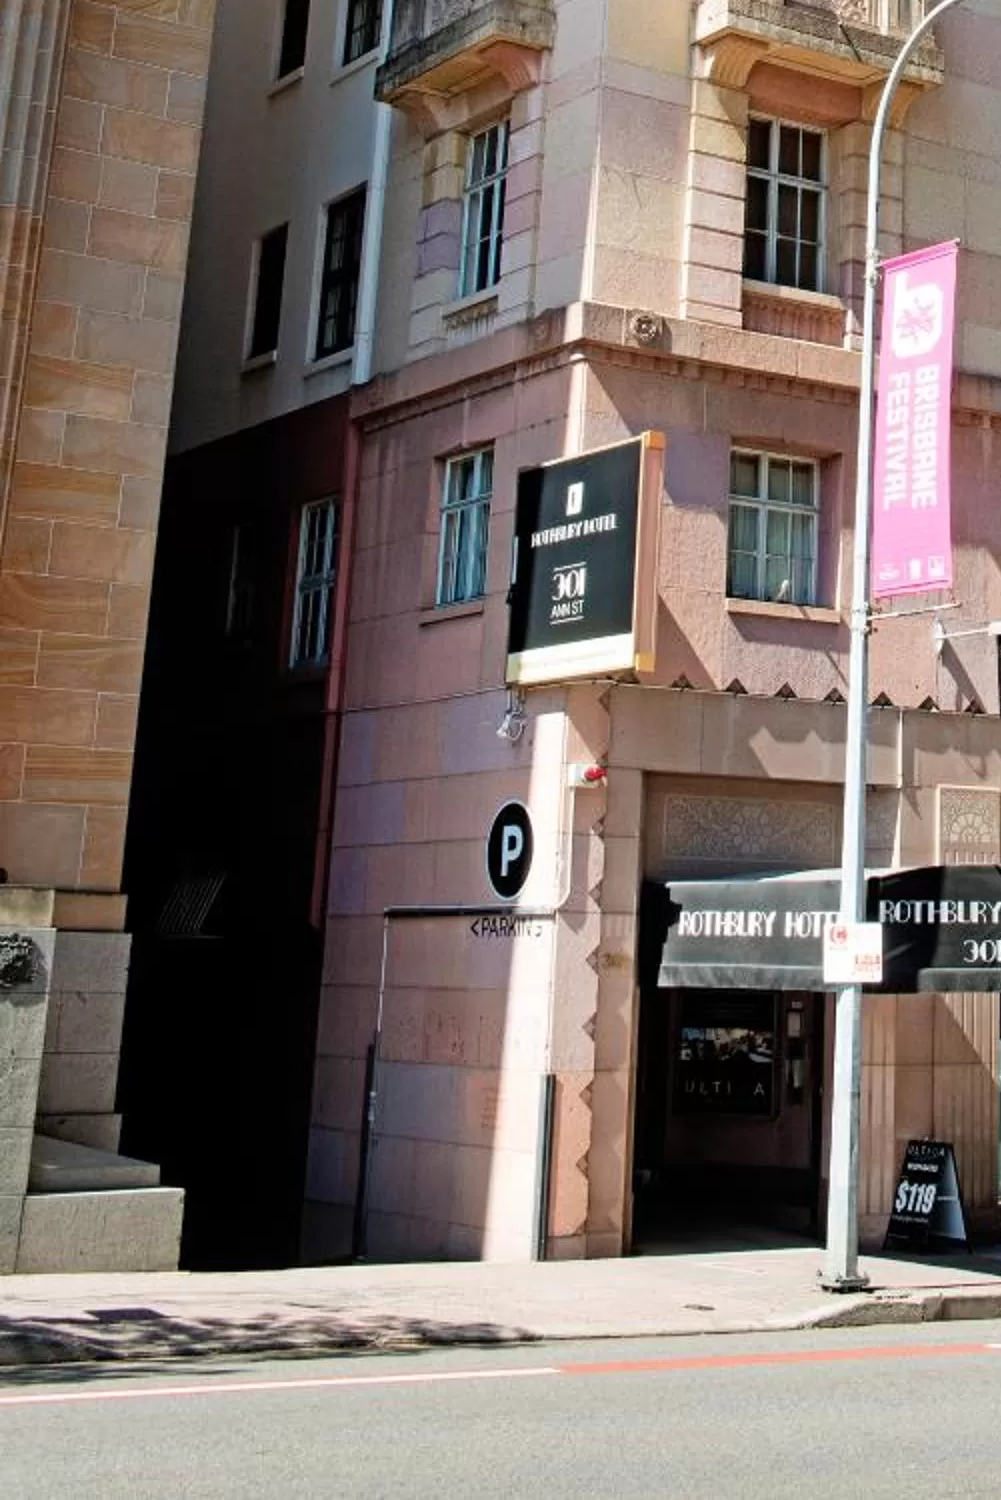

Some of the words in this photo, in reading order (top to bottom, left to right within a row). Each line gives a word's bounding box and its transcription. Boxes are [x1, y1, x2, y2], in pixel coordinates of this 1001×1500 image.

[883, 371, 910, 511] FESTIVAL
[911, 364, 939, 509] BRISBANE
[553, 568, 587, 600] 301
[551, 602, 571, 619] ANN
[571, 599, 585, 614] ST
[501, 824, 524, 877] P
[677, 911, 776, 937] ROTHBURY
[784, 911, 842, 938] HOT
[684, 1078, 766, 1096] ULTIA
[895, 1179, 936, 1214] $119
